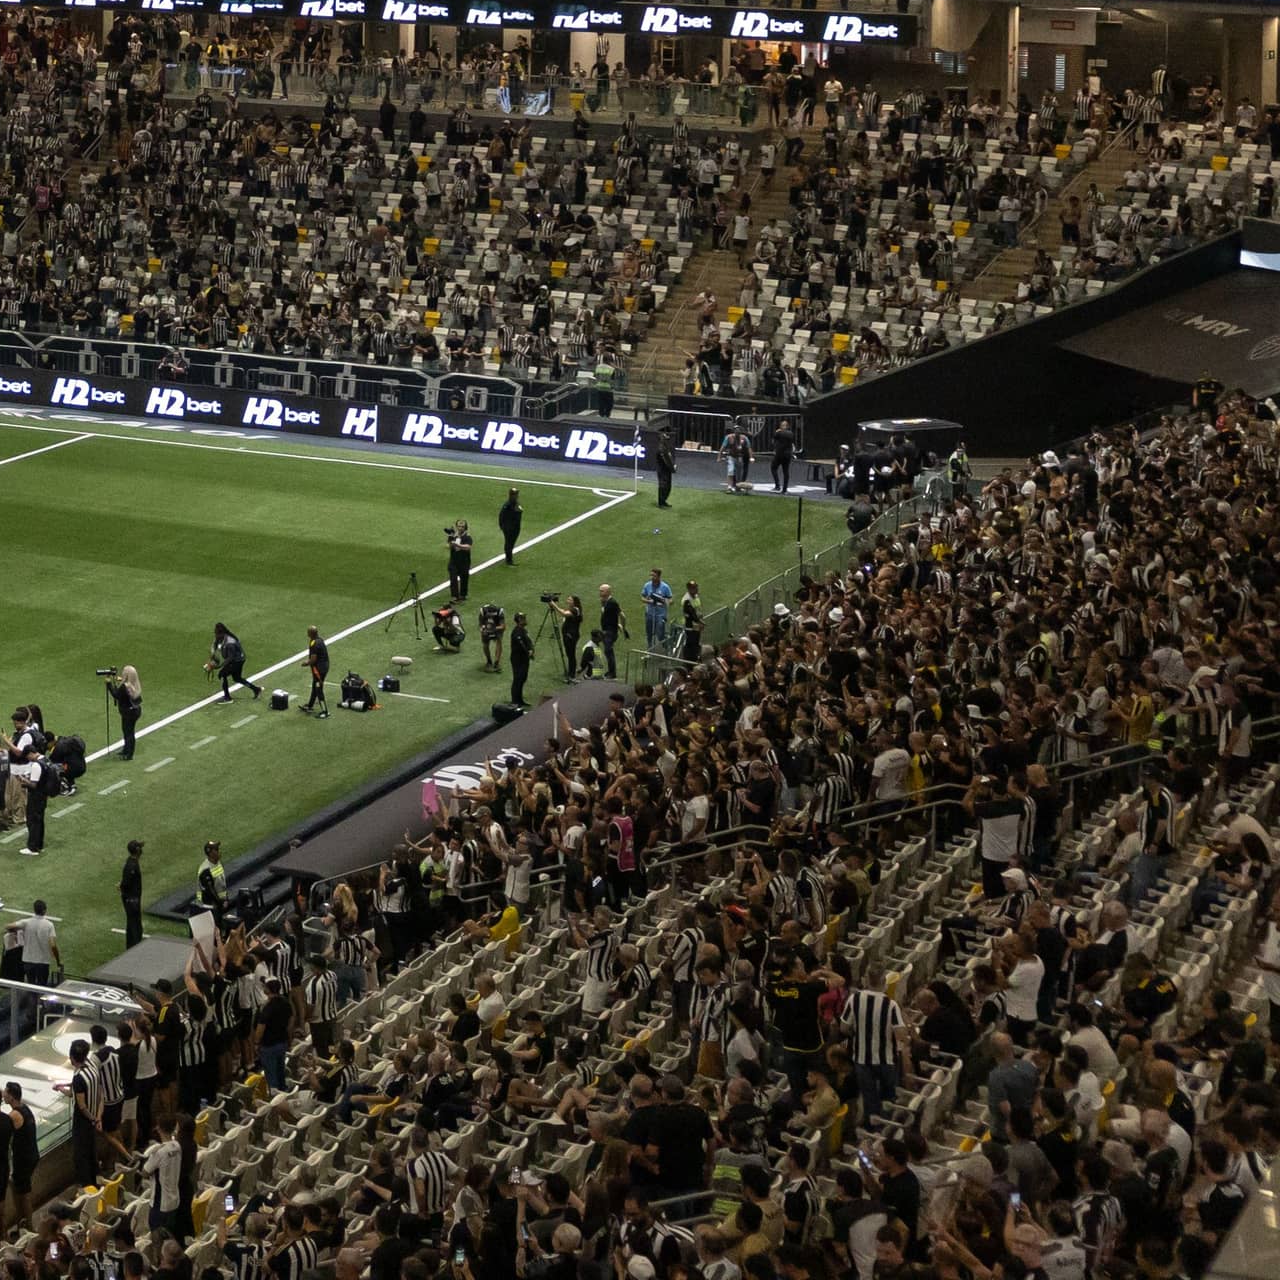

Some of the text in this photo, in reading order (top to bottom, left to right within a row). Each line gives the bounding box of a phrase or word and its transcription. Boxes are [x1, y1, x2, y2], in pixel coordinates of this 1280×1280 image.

[641, 7, 712, 33] H2bet
[730, 12, 803, 38] H2bet
[822, 16, 898, 43] H2bet
[1183, 314, 1252, 337] MRV
[50, 377, 125, 406] H2bet
[145, 387, 222, 417] H2bet
[242, 397, 319, 427] H2bet
[401, 413, 479, 445] H2bet
[481, 421, 560, 454] H2bet
[565, 429, 646, 462] H2bet
